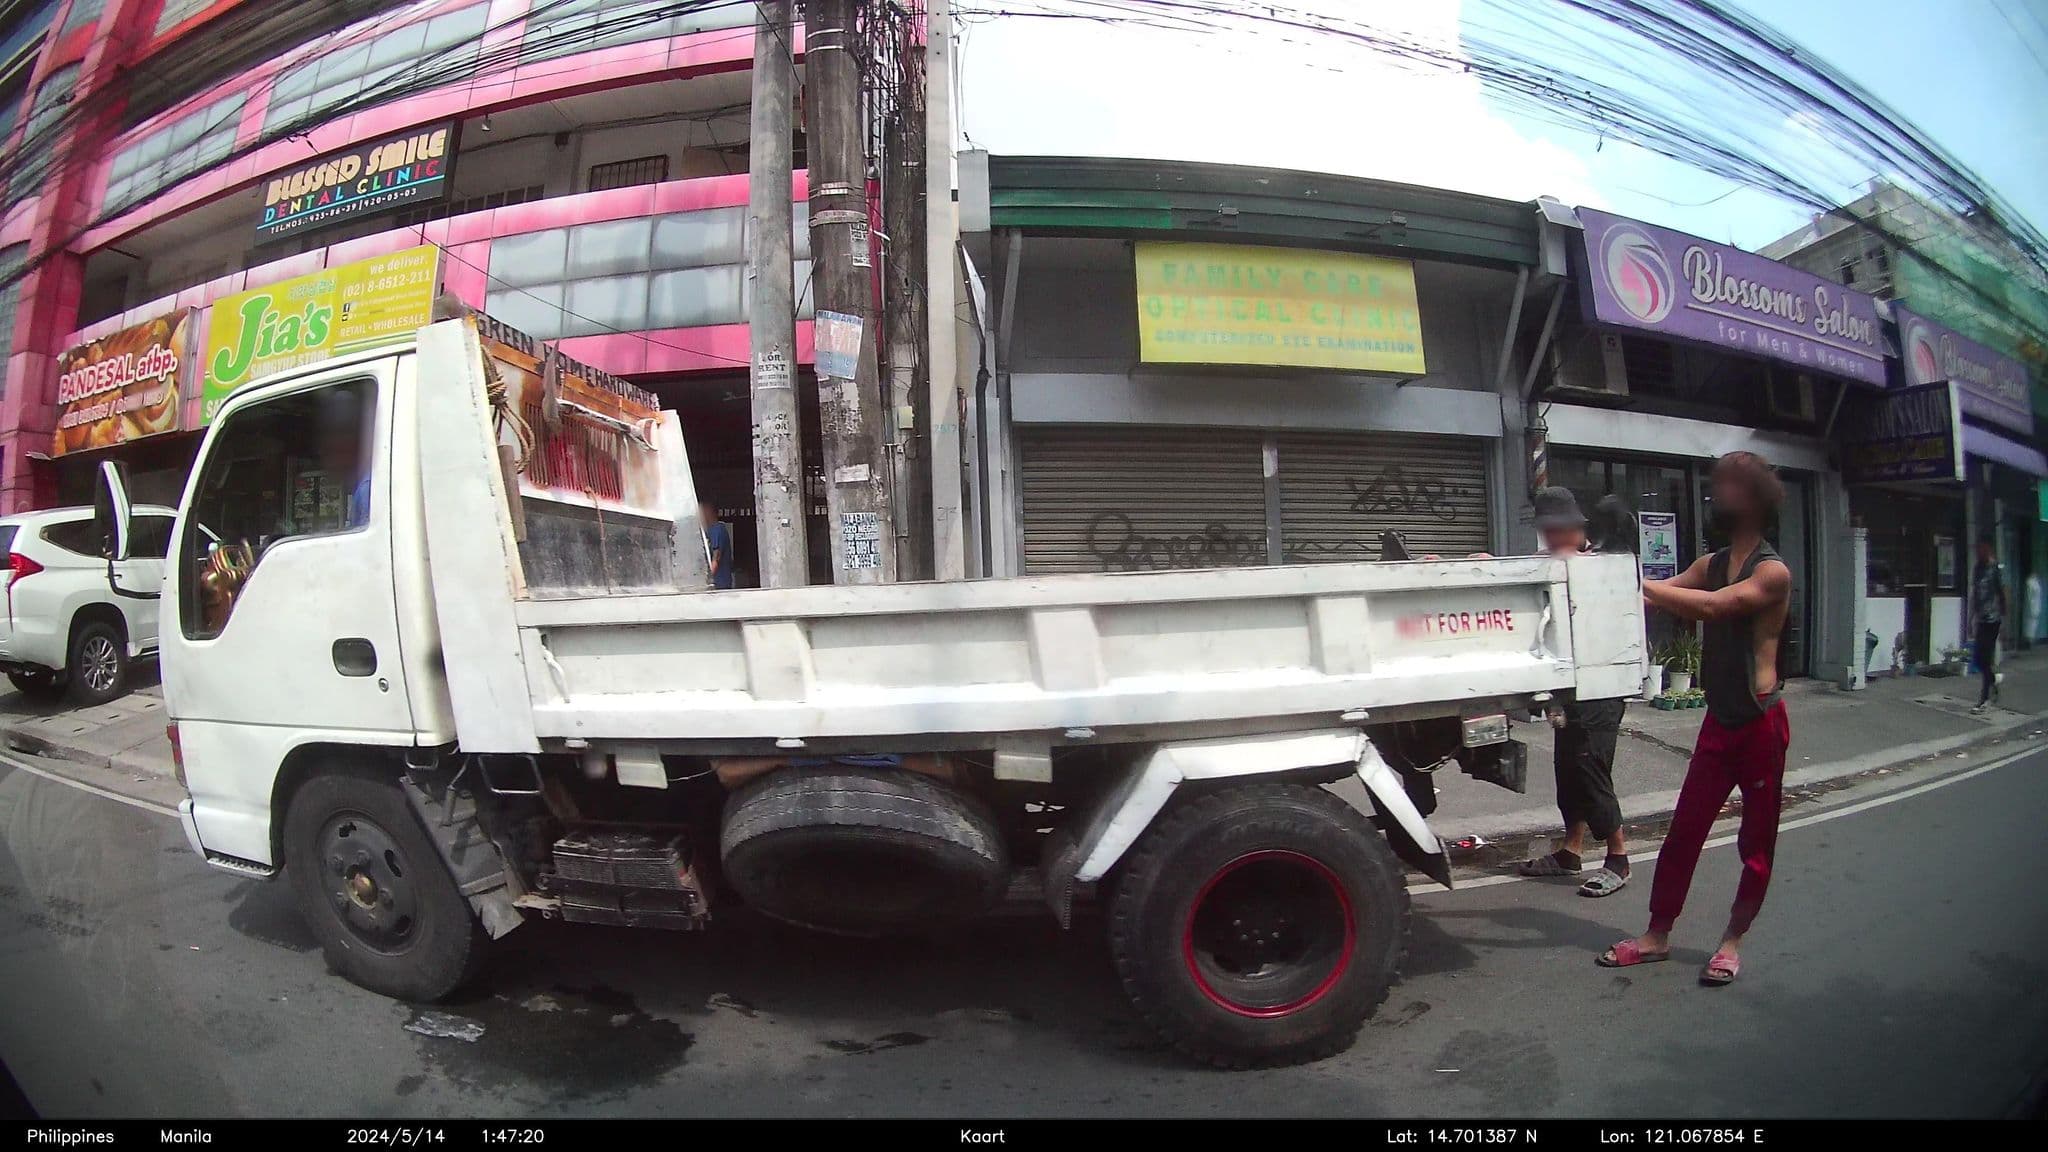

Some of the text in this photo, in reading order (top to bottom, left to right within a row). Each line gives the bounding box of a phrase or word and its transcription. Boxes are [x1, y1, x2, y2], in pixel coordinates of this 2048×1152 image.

[265, 129, 447, 207] BLESSED SMILE
[264, 160, 440, 223] DENTAL CLINIC
[343, 283, 365, 301] (02)
[367, 270, 431, 293] 8-6512-211
[370, 264, 385, 275] we
[1162, 262, 1382, 297] FAMILY CARE
[1145, 296, 1416, 332] OPTICAL CLINIC
[1682, 246, 1874, 346] Blossoms Salon
[213, 295, 334, 384] Jia's
[340, 324, 366, 338] RETAIL
[1718, 320, 1865, 374] for Men & Women
[58, 353, 135, 404] PANDESAL
[1438, 612, 1472, 634] FOR
[1475, 609, 1514, 632] HIRE
